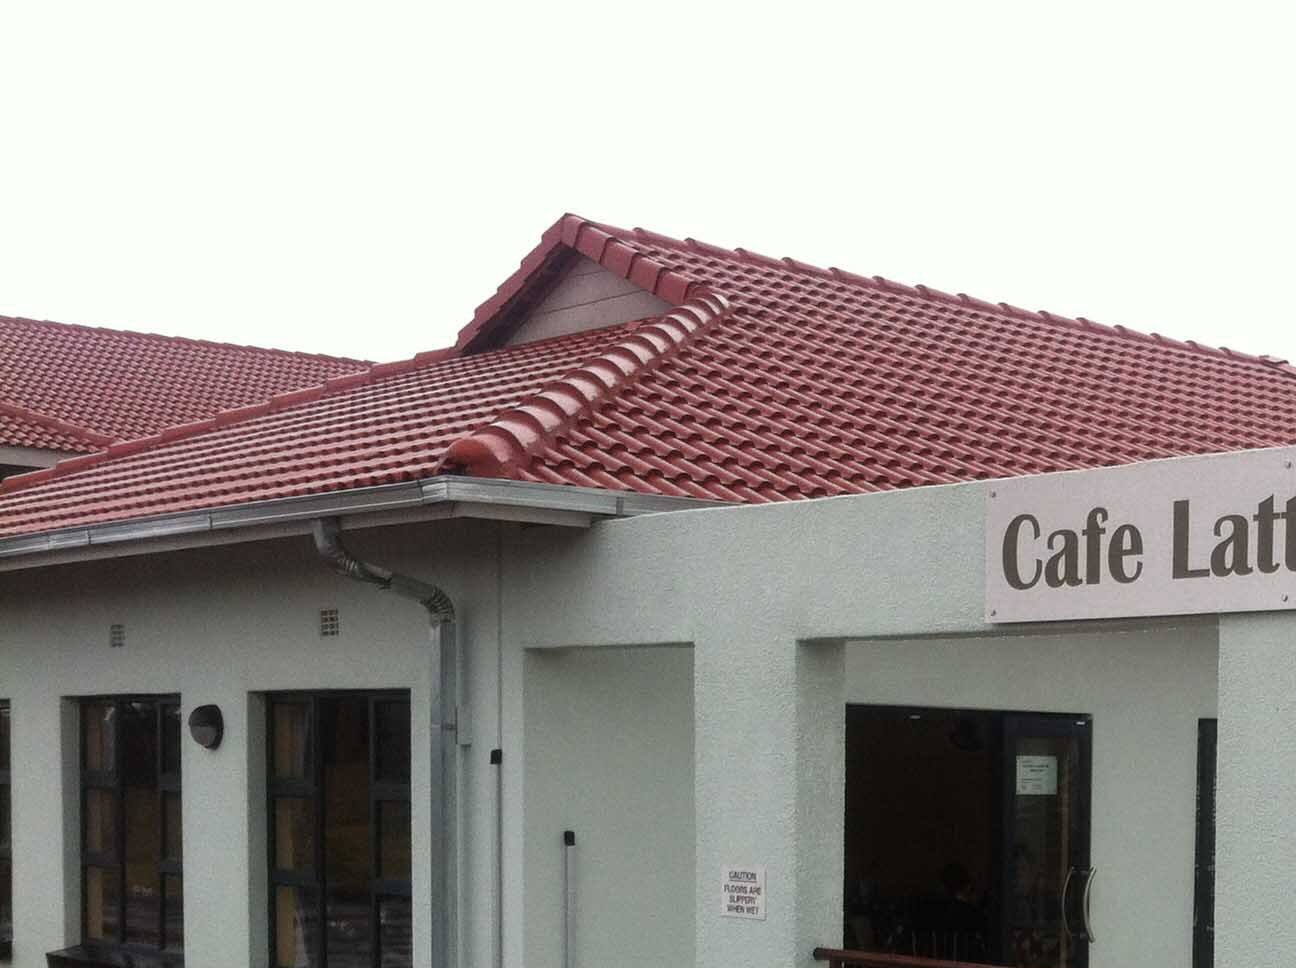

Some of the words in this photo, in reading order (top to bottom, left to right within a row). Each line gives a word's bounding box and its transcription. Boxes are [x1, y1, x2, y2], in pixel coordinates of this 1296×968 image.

[1002, 507, 1143, 590] Cafe
[728, 871, 757, 880] CAUTION
[723, 884, 748, 894] FLOORS
[749, 886, 761, 895] ARE
